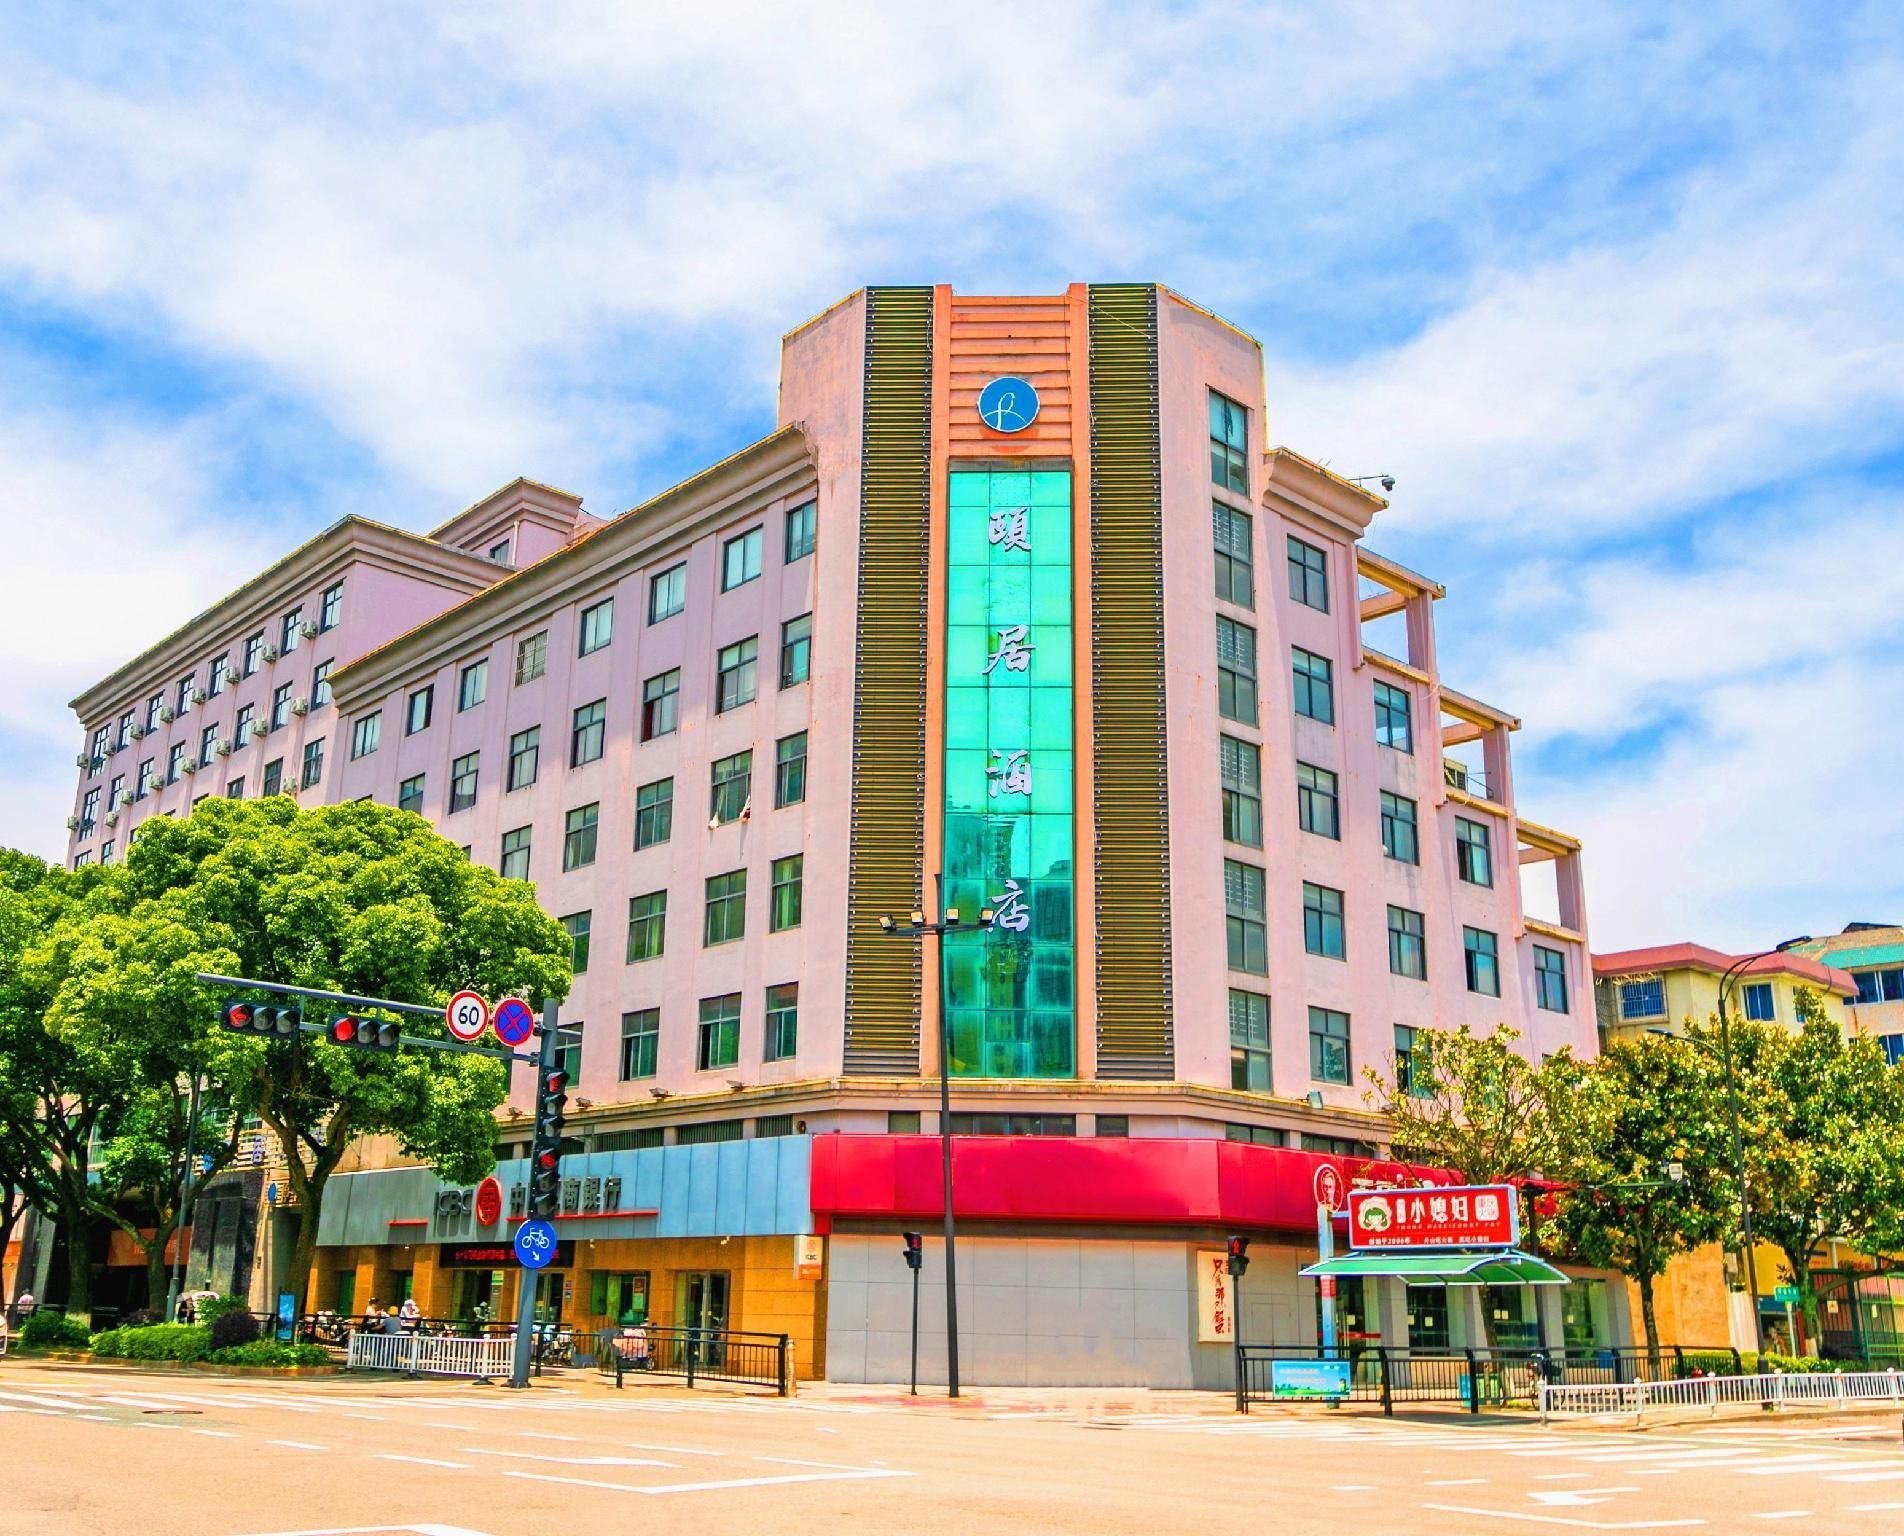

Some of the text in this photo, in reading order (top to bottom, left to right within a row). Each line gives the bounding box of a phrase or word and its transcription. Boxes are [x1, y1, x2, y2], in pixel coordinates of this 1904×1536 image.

[458, 1005, 479, 1026] 60
[434, 1190, 473, 1216] ICBC
[1411, 1196, 1469, 1223] 小媳妇
